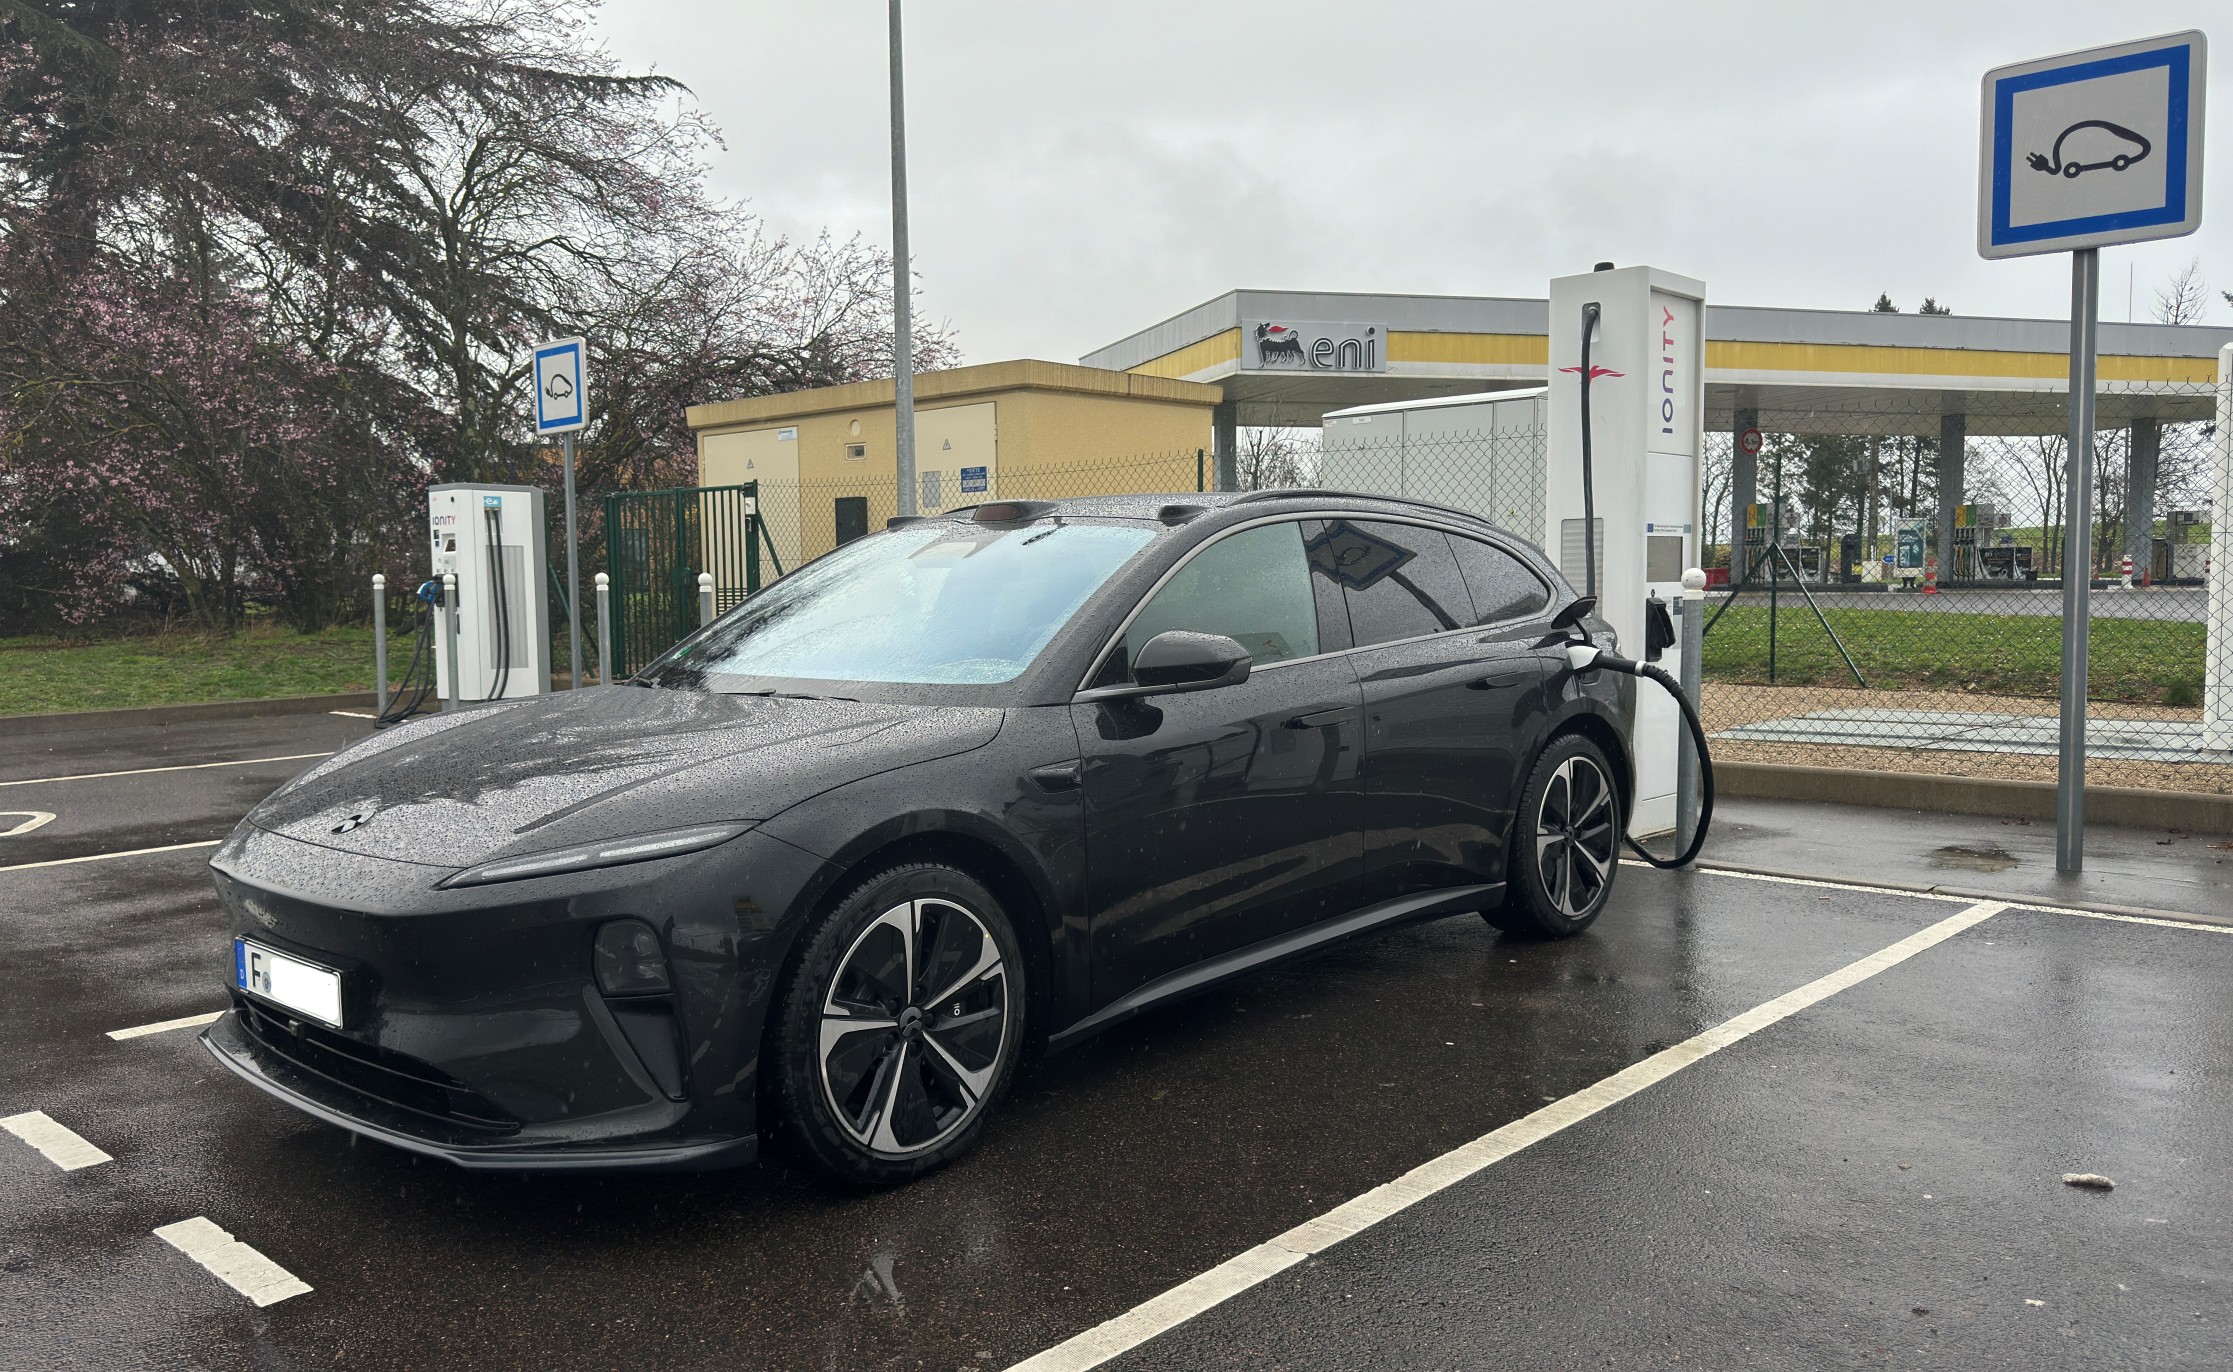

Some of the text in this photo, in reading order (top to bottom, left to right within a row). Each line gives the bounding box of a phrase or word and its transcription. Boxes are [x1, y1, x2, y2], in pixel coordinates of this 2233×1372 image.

[1309, 326, 1376, 369] eni
[1662, 305, 1675, 434] IONITY
[432, 515, 456, 526] IONITY
[251, 952, 261, 988] F
